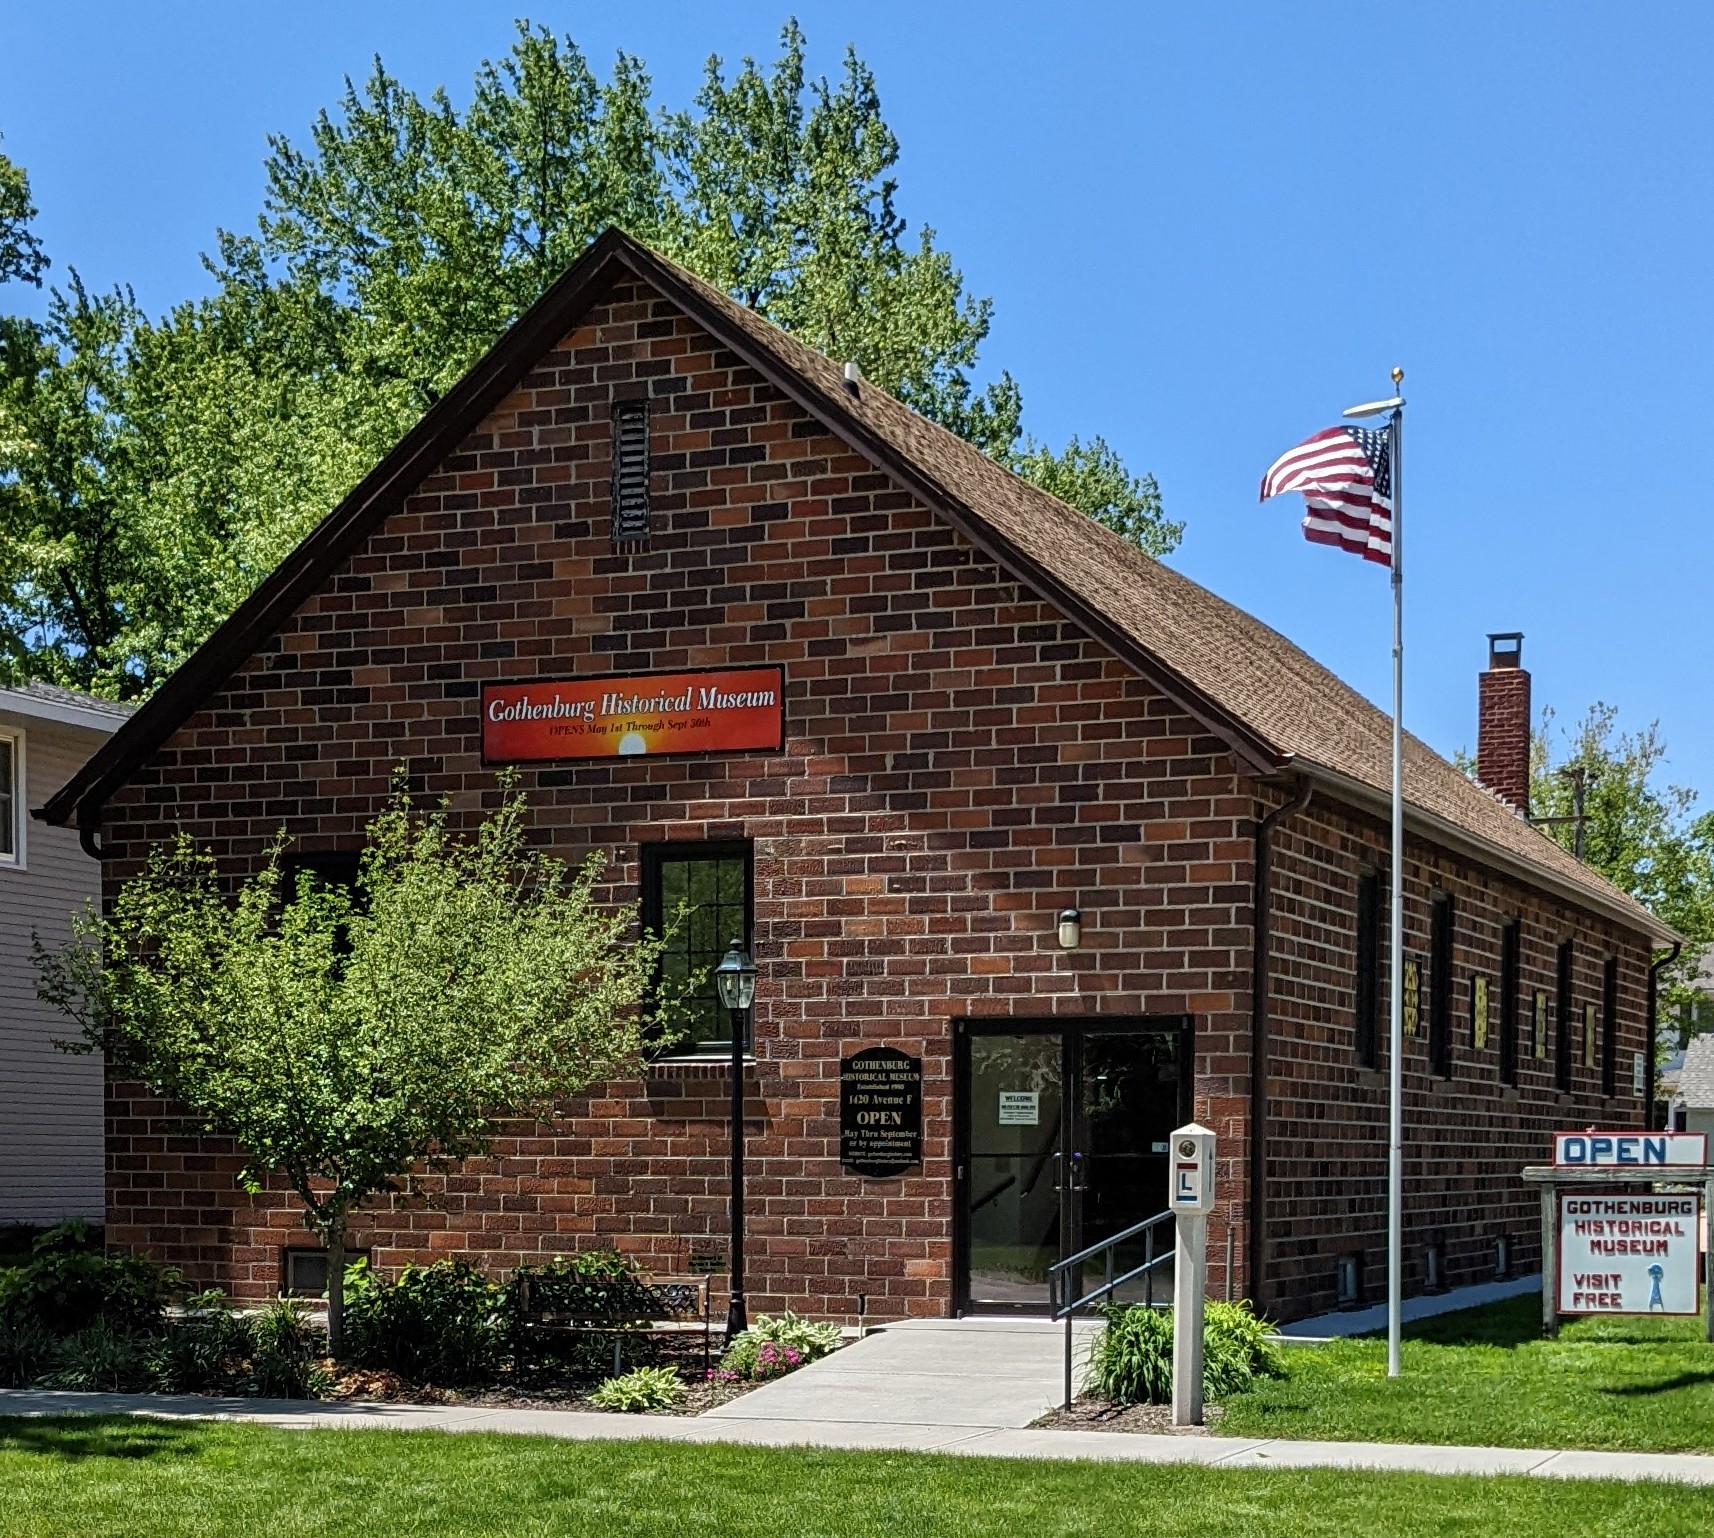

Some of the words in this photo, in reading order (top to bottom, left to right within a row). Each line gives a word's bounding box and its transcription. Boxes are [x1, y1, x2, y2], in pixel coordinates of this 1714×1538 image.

[488, 694, 596, 723] Gothenburg
[600, 687, 692, 715] Historical
[697, 686, 775, 710] Museum
[550, 724, 585, 736] OPENS
[588, 724, 608, 735] May
[610, 723, 623, 734] 1st
[626, 720, 664, 732] Through
[668, 719, 687, 731] Sept
[690, 717, 711, 728] 30th
[852, 1060, 910, 1070] GOTHENBURG
[842, 1073, 887, 1081] HISTORICAL
[889, 1073, 920, 1081] MUSEUM
[848, 1094, 870, 1105] 1420
[872, 1094, 904, 1105] Avenue
[906, 1094, 913, 1105] F
[856, 1111, 903, 1125] OPEN
[844, 1129, 859, 1139] May
[861, 1129, 879, 1138] Thru
[1563, 1137, 1666, 1163] OPEN
[1181, 1173, 1193, 1191] L
[1567, 1200, 1692, 1215] GOTHENBURG
[1574, 1219, 1685, 1235] HISTORICAL
[1589, 1239, 1669, 1255] MUSEUM
[1573, 1273, 1622, 1289] VISIT
[1573, 1292, 1622, 1308] FREE
